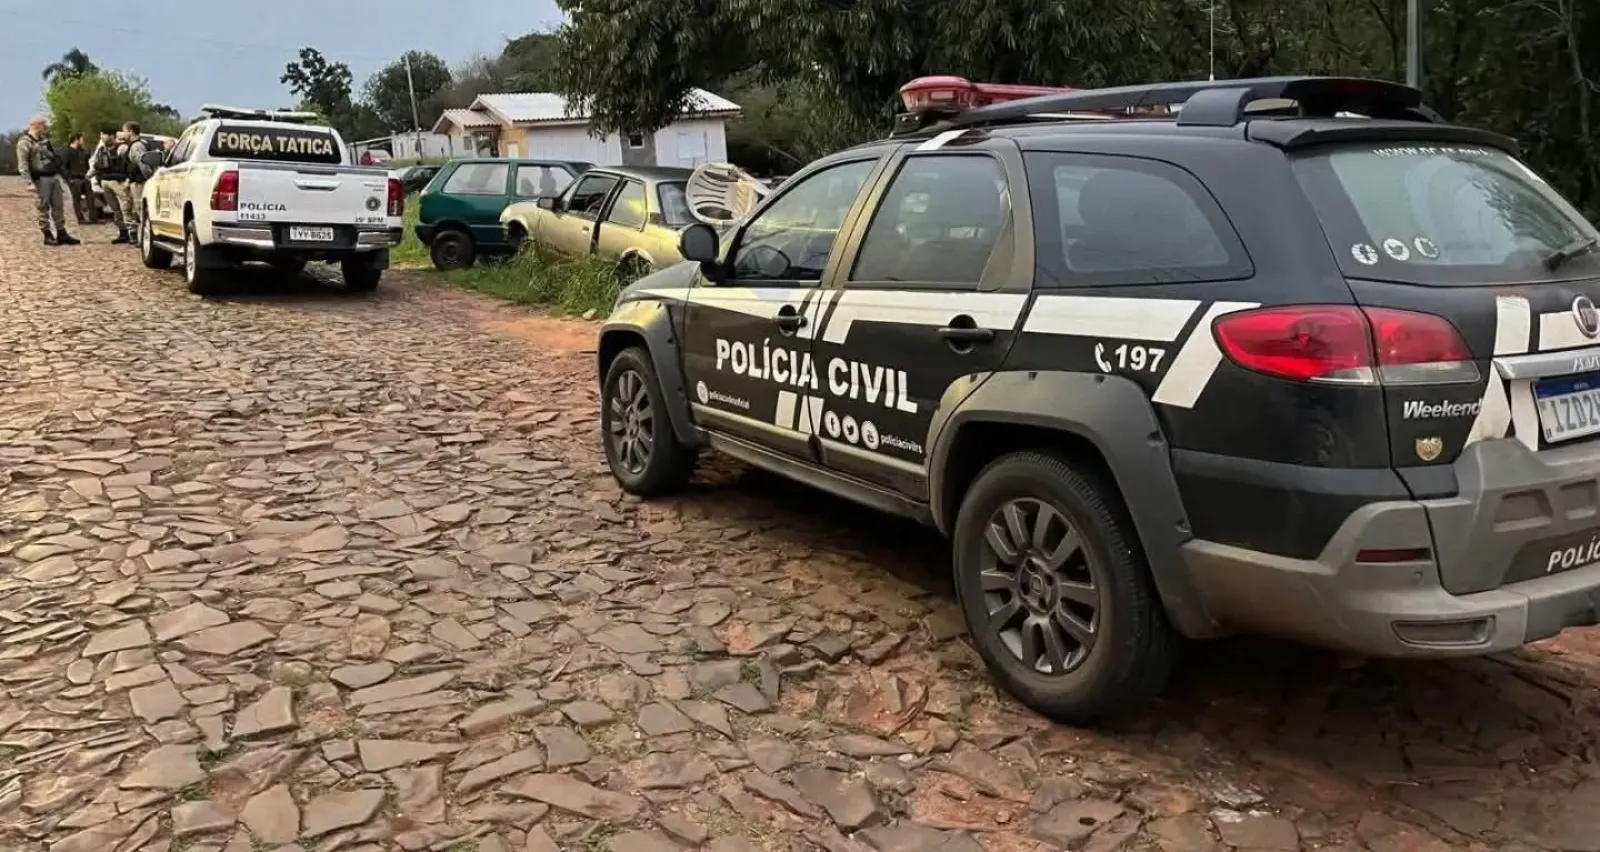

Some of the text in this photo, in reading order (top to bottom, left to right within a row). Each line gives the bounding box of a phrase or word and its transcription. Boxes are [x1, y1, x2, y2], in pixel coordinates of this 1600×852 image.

[217, 131, 273, 155] FORÇA
[240, 201, 287, 212] POLÍCIA
[1115, 344, 1165, 373] 197
[716, 337, 918, 414] POLÍCIA CIVIL
[1403, 398, 1484, 419] Weekend
